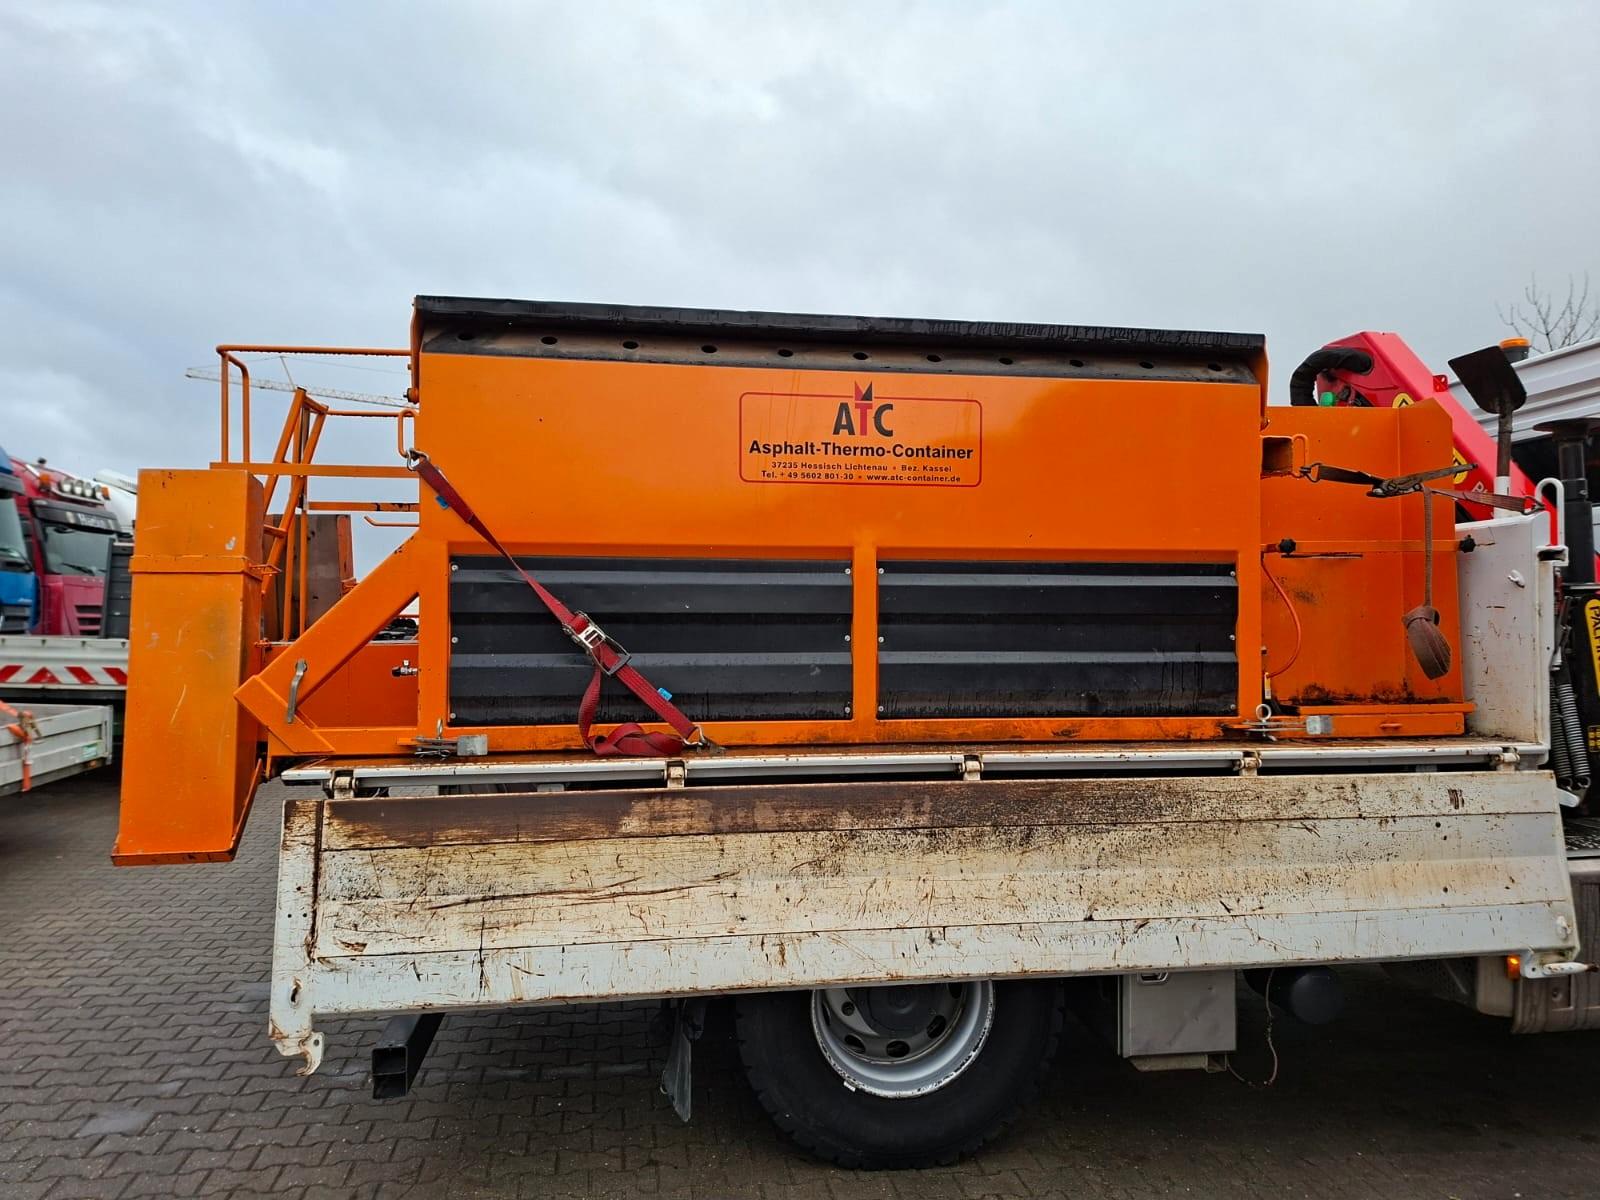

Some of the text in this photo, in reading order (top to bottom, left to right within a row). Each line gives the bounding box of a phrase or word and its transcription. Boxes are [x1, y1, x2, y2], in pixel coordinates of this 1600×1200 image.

[832, 402, 893, 437] ATC
[749, 440, 974, 459] Asphalt-Thermo-Container
[801, 462, 842, 470] Hessisch
[845, 463, 888, 471] Lichtenau
[761, 470, 778, 478] Tel.
[866, 474, 961, 482] www.atc-container.de
